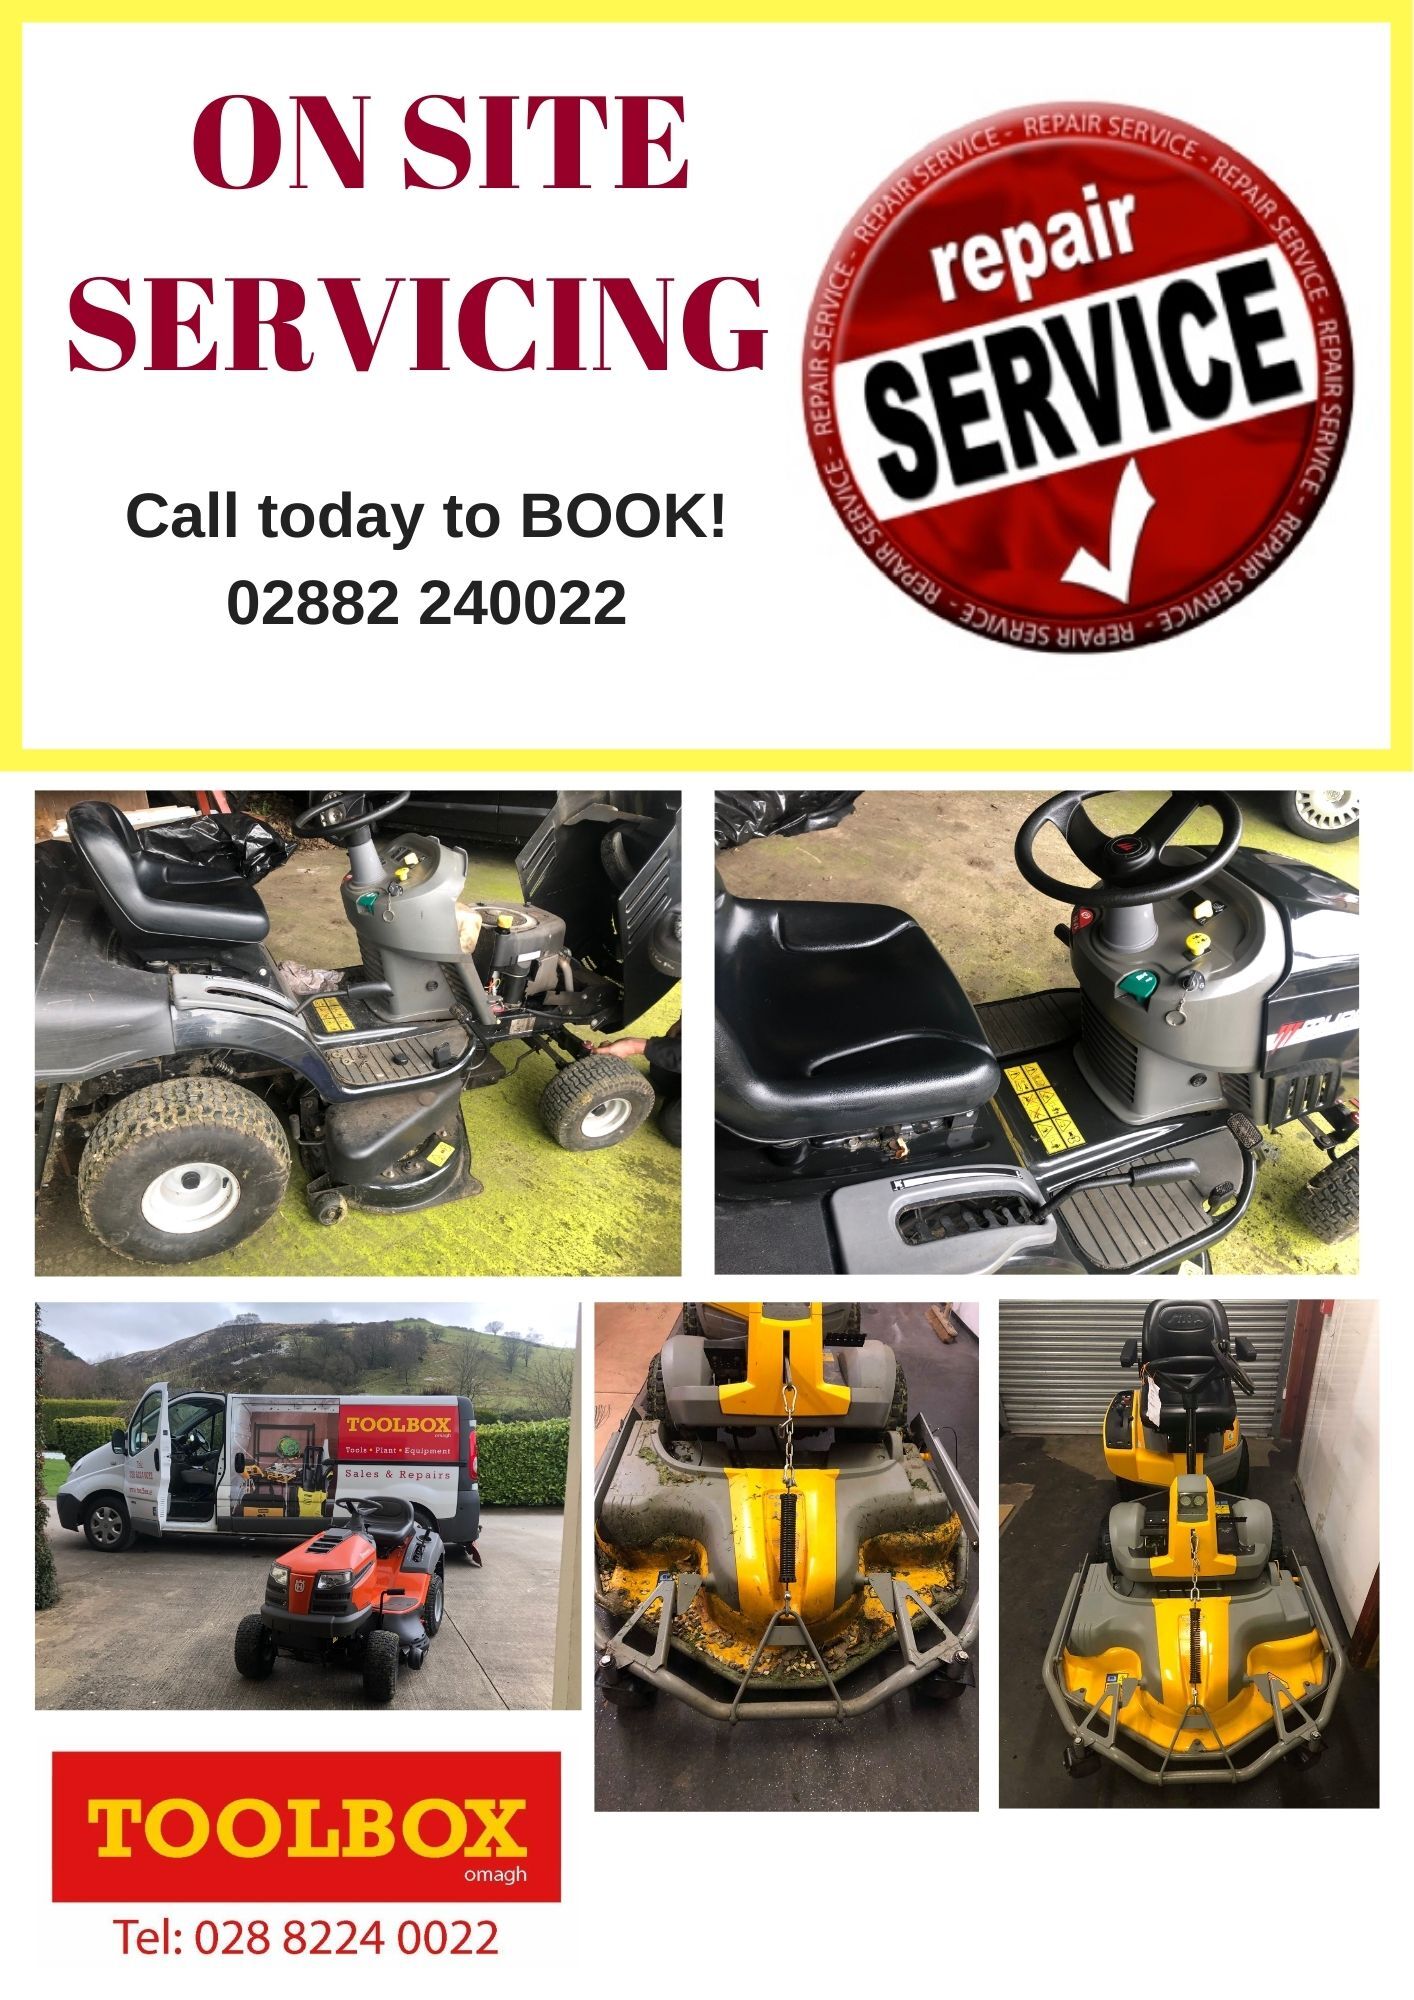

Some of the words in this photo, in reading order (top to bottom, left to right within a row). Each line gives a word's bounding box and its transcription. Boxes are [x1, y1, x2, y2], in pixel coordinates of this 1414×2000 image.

[191, 95, 371, 190] ON
[404, 95, 689, 190] SITE
[1023, 113, 1101, 137] REPAIR
[1108, 116, 1199, 160] SERVICE
[852, 175, 917, 245] REPAIR
[912, 125, 999, 186] SERVICE
[930, 184, 1136, 303] repair
[1210, 155, 1278, 219] REPAIR
[1270, 214, 1328, 302] SERVICE
[69, 277, 768, 371] SERVICING
[812, 259, 854, 350] SERVICE
[864, 258, 1303, 502] SERVICE
[1317, 319, 1342, 395] REPAIR
[809, 358, 833, 435] REPAIR
[1298, 404, 1342, 495] SERVICE
[127, 491, 237, 539] Call
[258, 491, 424, 551] today
[443, 496, 500, 539] to
[522, 492, 724, 539] BOOK!
[823, 457, 882, 545] SERVICE
[873, 540, 942, 604] REPAIR
[1238, 511, 1302, 580] REPAIR
[227, 580, 399, 626] 02882
[420, 580, 626, 626] 240022
[958, 601, 1049, 644] SERVICE
[1156, 571, 1244, 631] SERVICE
[1056, 621, 1134, 647] REPAIR
[345, 1446, 367, 1454] Tools
[375, 1446, 397, 1454] Plant
[404, 1447, 451, 1456] Equipment
[347, 1417, 452, 1433] TOOLBOX
[345, 1469, 379, 1478] Sales
[385, 1469, 393, 1479] &
[400, 1470, 451, 1481] Repairs
[88, 1798, 528, 1859] TOOLBOX
[465, 1866, 527, 1886] omagh
[113, 1917, 182, 1955] Tel:
[194, 1919, 271, 1955] 028
[283, 1919, 386, 1955] 8224
[398, 1919, 499, 1955] 0022
